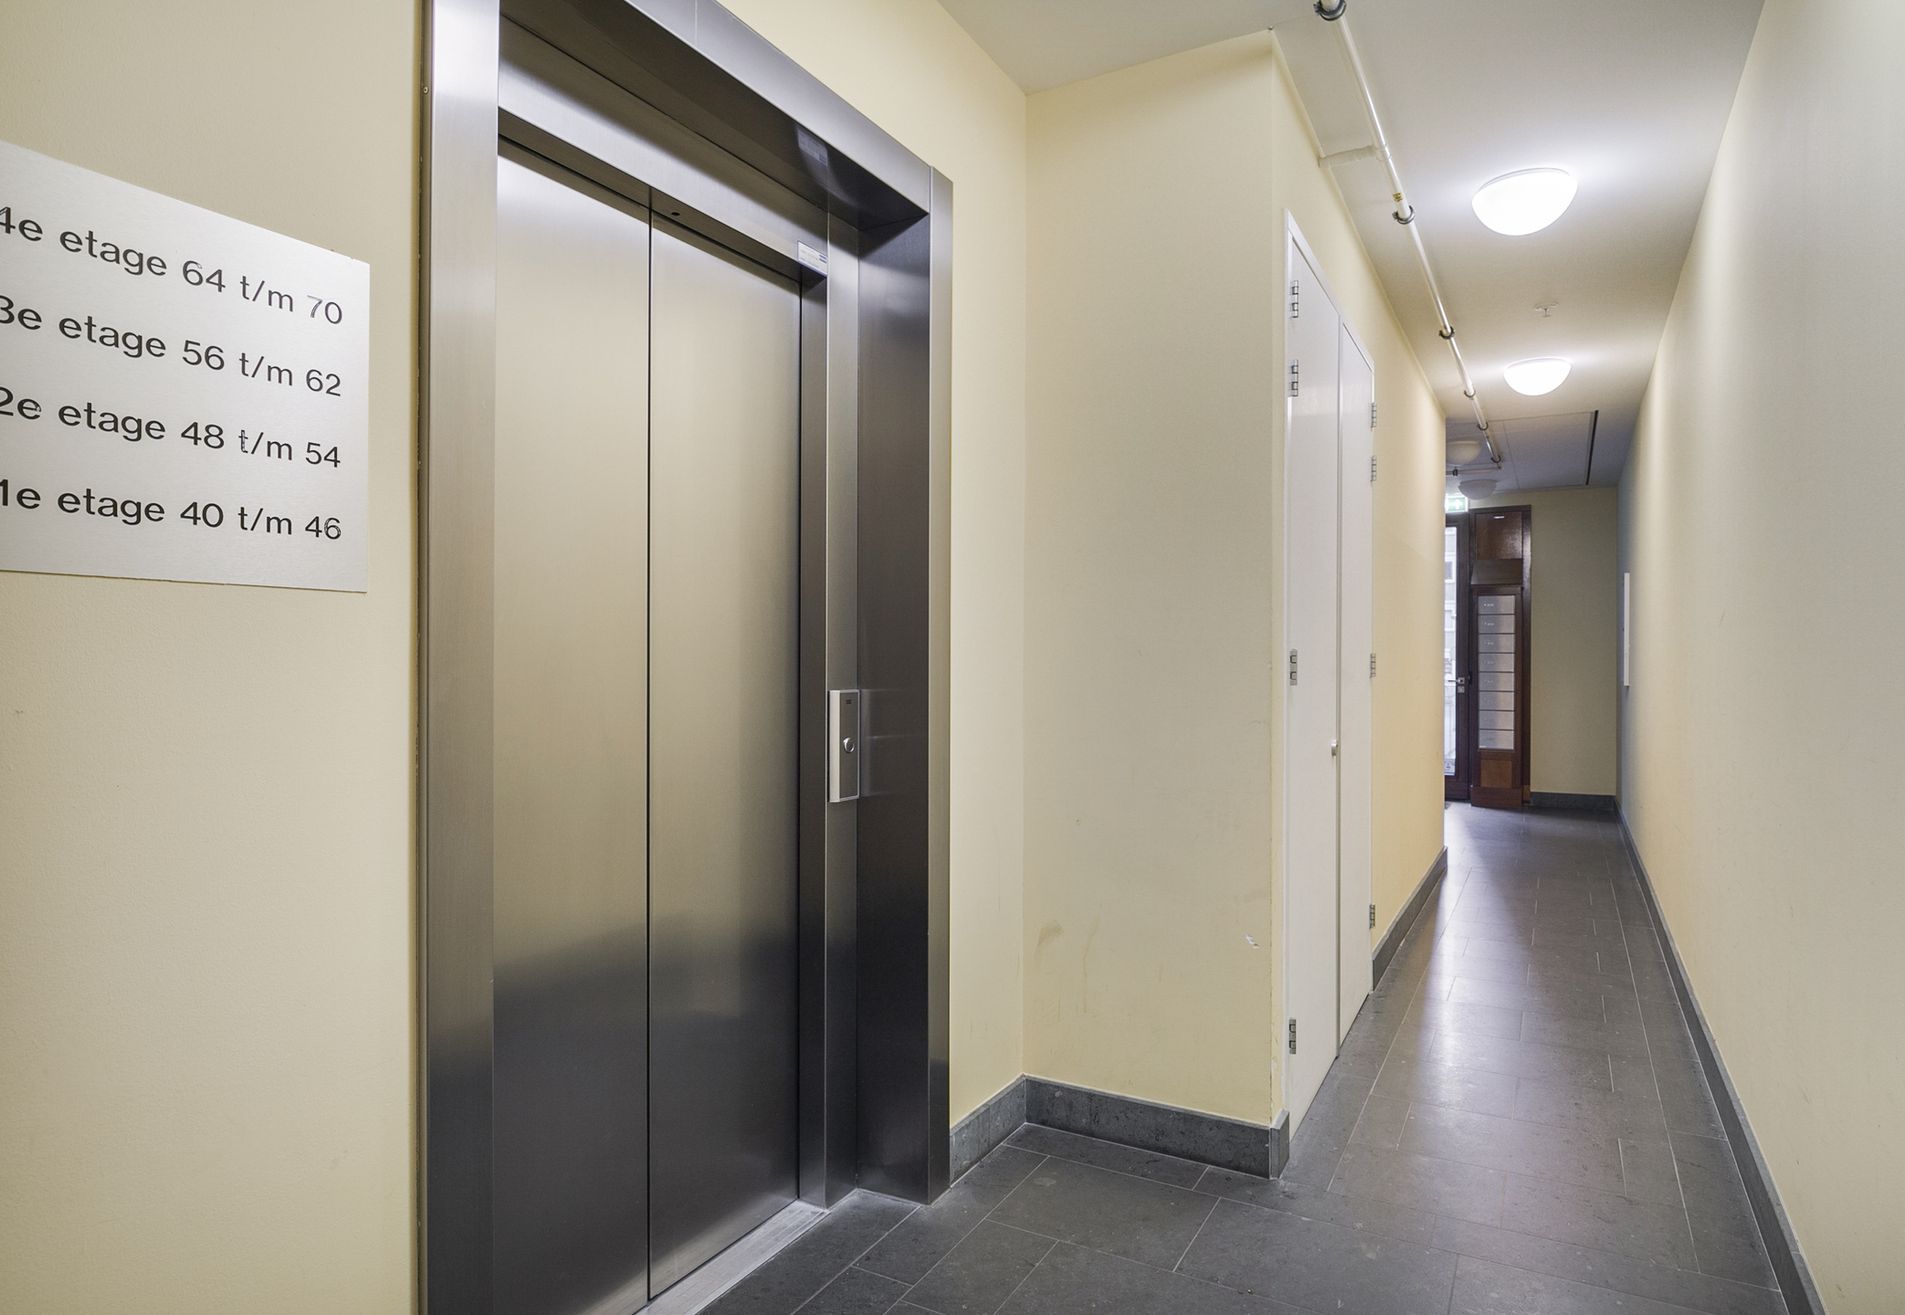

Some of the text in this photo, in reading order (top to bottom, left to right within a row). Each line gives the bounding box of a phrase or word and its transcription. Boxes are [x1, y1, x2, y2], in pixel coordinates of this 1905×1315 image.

[59, 230, 167, 276] etage
[182, 260, 226, 293] 64
[240, 275, 294, 312] t/m
[306, 295, 343, 325] 70
[59, 316, 166, 358] etage
[182, 340, 225, 371] 56
[239, 352, 294, 386] t/m
[305, 370, 342, 397] 62
[58, 402, 166, 442] etage
[181, 422, 225, 449] 48
[238, 429, 293, 461] t/m
[305, 442, 341, 468] 54
[57, 488, 165, 525] etage
[180, 502, 224, 528] 40
[238, 507, 293, 535] t/m
[304, 517, 342, 540] 46
